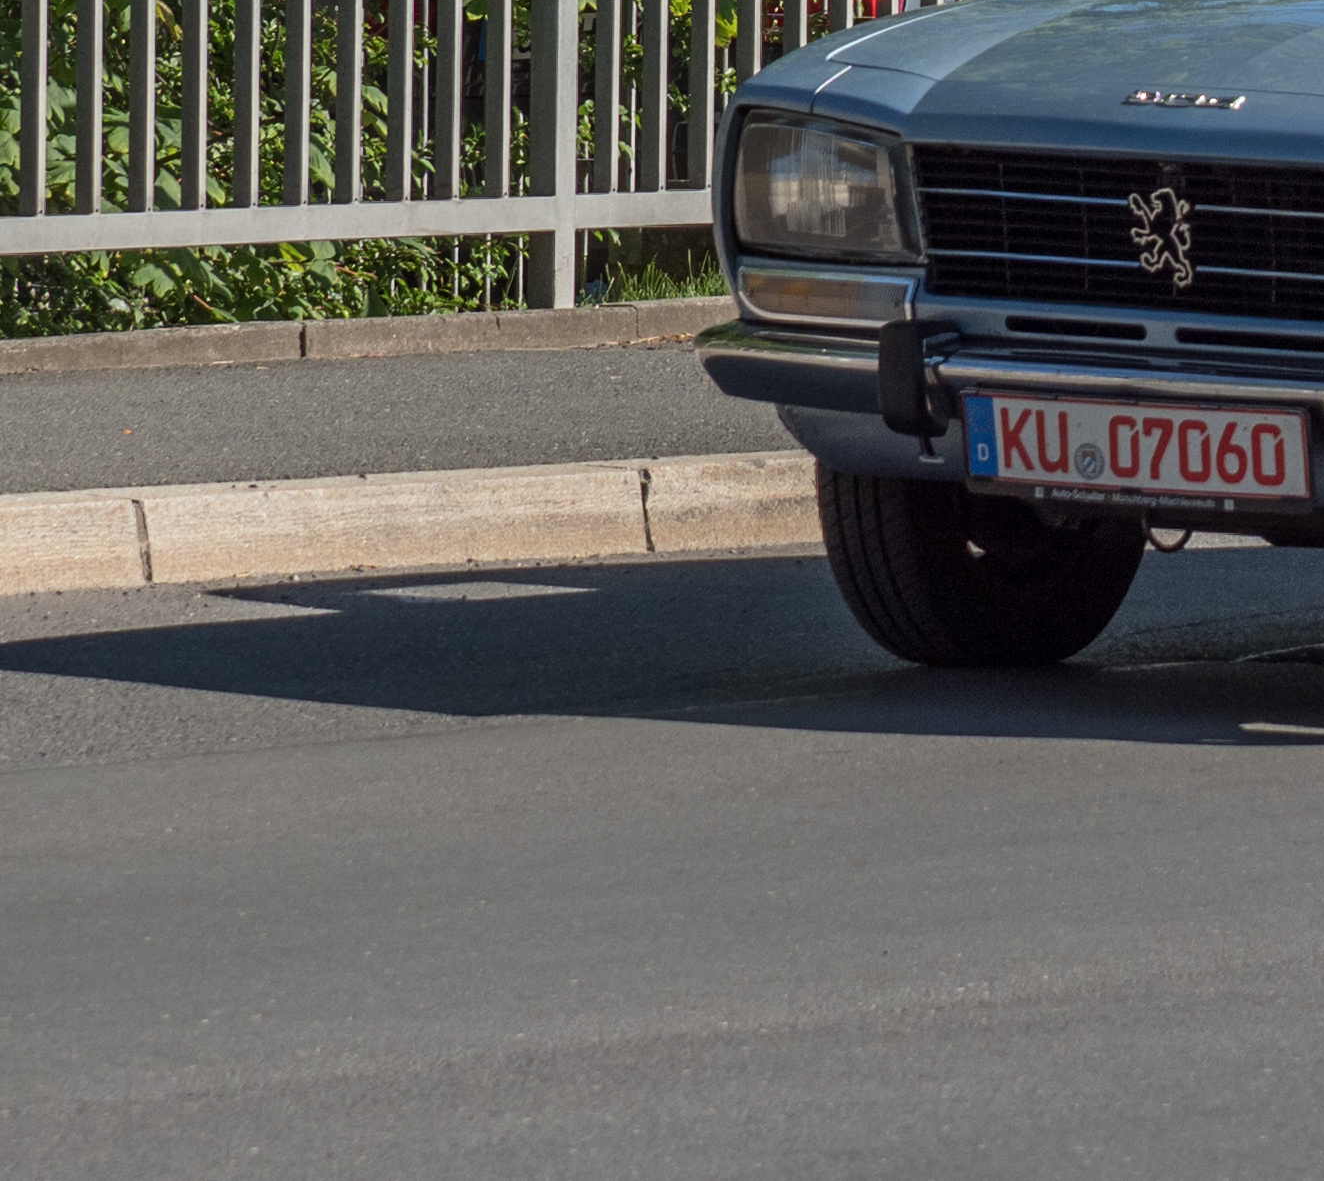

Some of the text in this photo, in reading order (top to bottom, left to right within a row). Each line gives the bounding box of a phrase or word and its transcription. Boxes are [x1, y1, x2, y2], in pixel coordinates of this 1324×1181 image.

[976, 443, 990, 461] D
[1000, 406, 1286, 487] KU 07060
